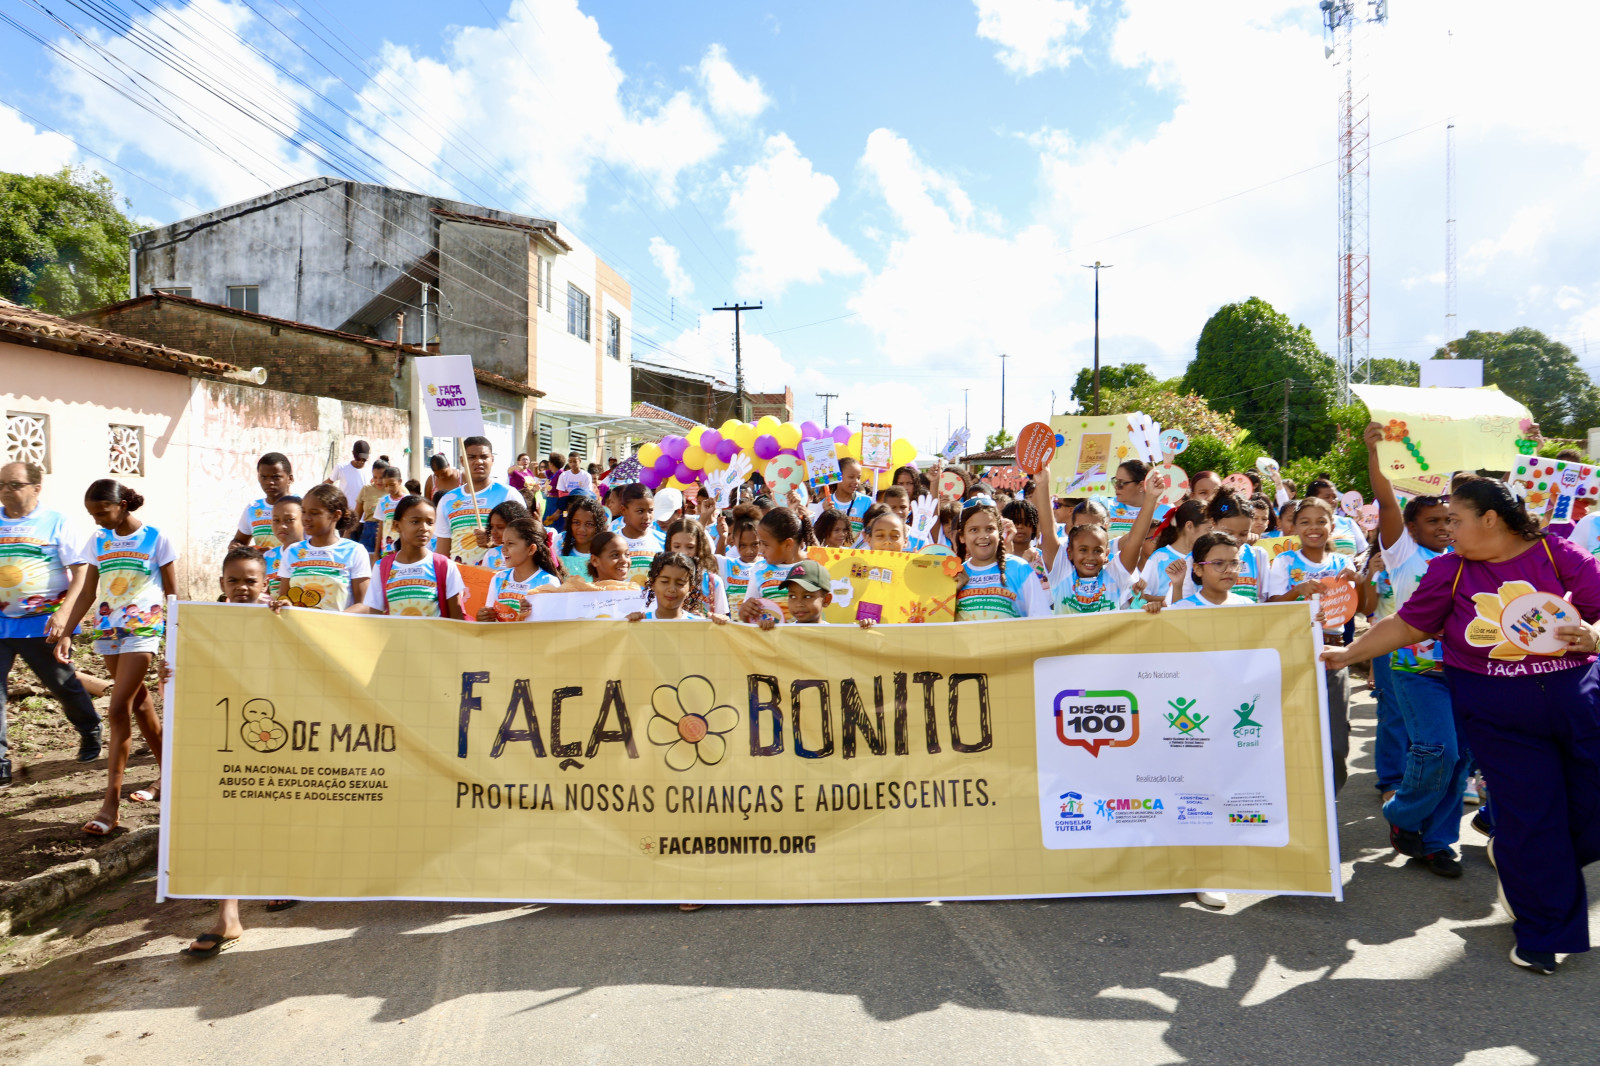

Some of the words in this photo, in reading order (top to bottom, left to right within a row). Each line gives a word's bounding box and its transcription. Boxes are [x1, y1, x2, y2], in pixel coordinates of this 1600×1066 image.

[438, 385, 462, 397] FAÇA
[436, 398, 466, 407] BONITO
[1138, 671, 1152, 679] Ação
[1153, 671, 1180, 679] Nacional:
[1069, 704, 1126, 714] DISQUE
[216, 697, 288, 753] 18
[292, 720, 321, 752] DE
[330, 723, 396, 752] MAIO
[457, 671, 640, 771] FAÇA
[746, 671, 993, 760] BONITO
[1067, 715, 1125, 733] 100
[1237, 740, 1259, 748] Brasil
[223, 764, 241, 773] DIA
[245, 765, 298, 775] NACIONAL
[301, 767, 314, 775] DE
[317, 767, 367, 776] COMBATE
[370, 767, 385, 776] AO
[218, 778, 256, 786] ABUSO
[258, 778, 265, 786] E
[267, 776, 275, 787] À
[278, 778, 346, 790] EXPLORAÇÃO
[349, 780, 388, 789] SEXUAL
[1136, 775, 1166, 783] Realização
[223, 790, 237, 798] DE
[239, 790, 292, 801] CRIANÇAS
[295, 791, 301, 799] E
[304, 792, 383, 801] ADOLESCENTES
[456, 782, 554, 811] PROTEJA
[565, 783, 655, 812] NOSSAS
[665, 784, 784, 820] CRIANÇAS
[795, 784, 805, 812] E
[815, 778, 997, 812] ADOLESCENTES.
[1106, 799, 1164, 810] CMDCA
[1229, 814, 1268, 823] BRASIL
[659, 835, 816, 855] FACABONITO.ORG
